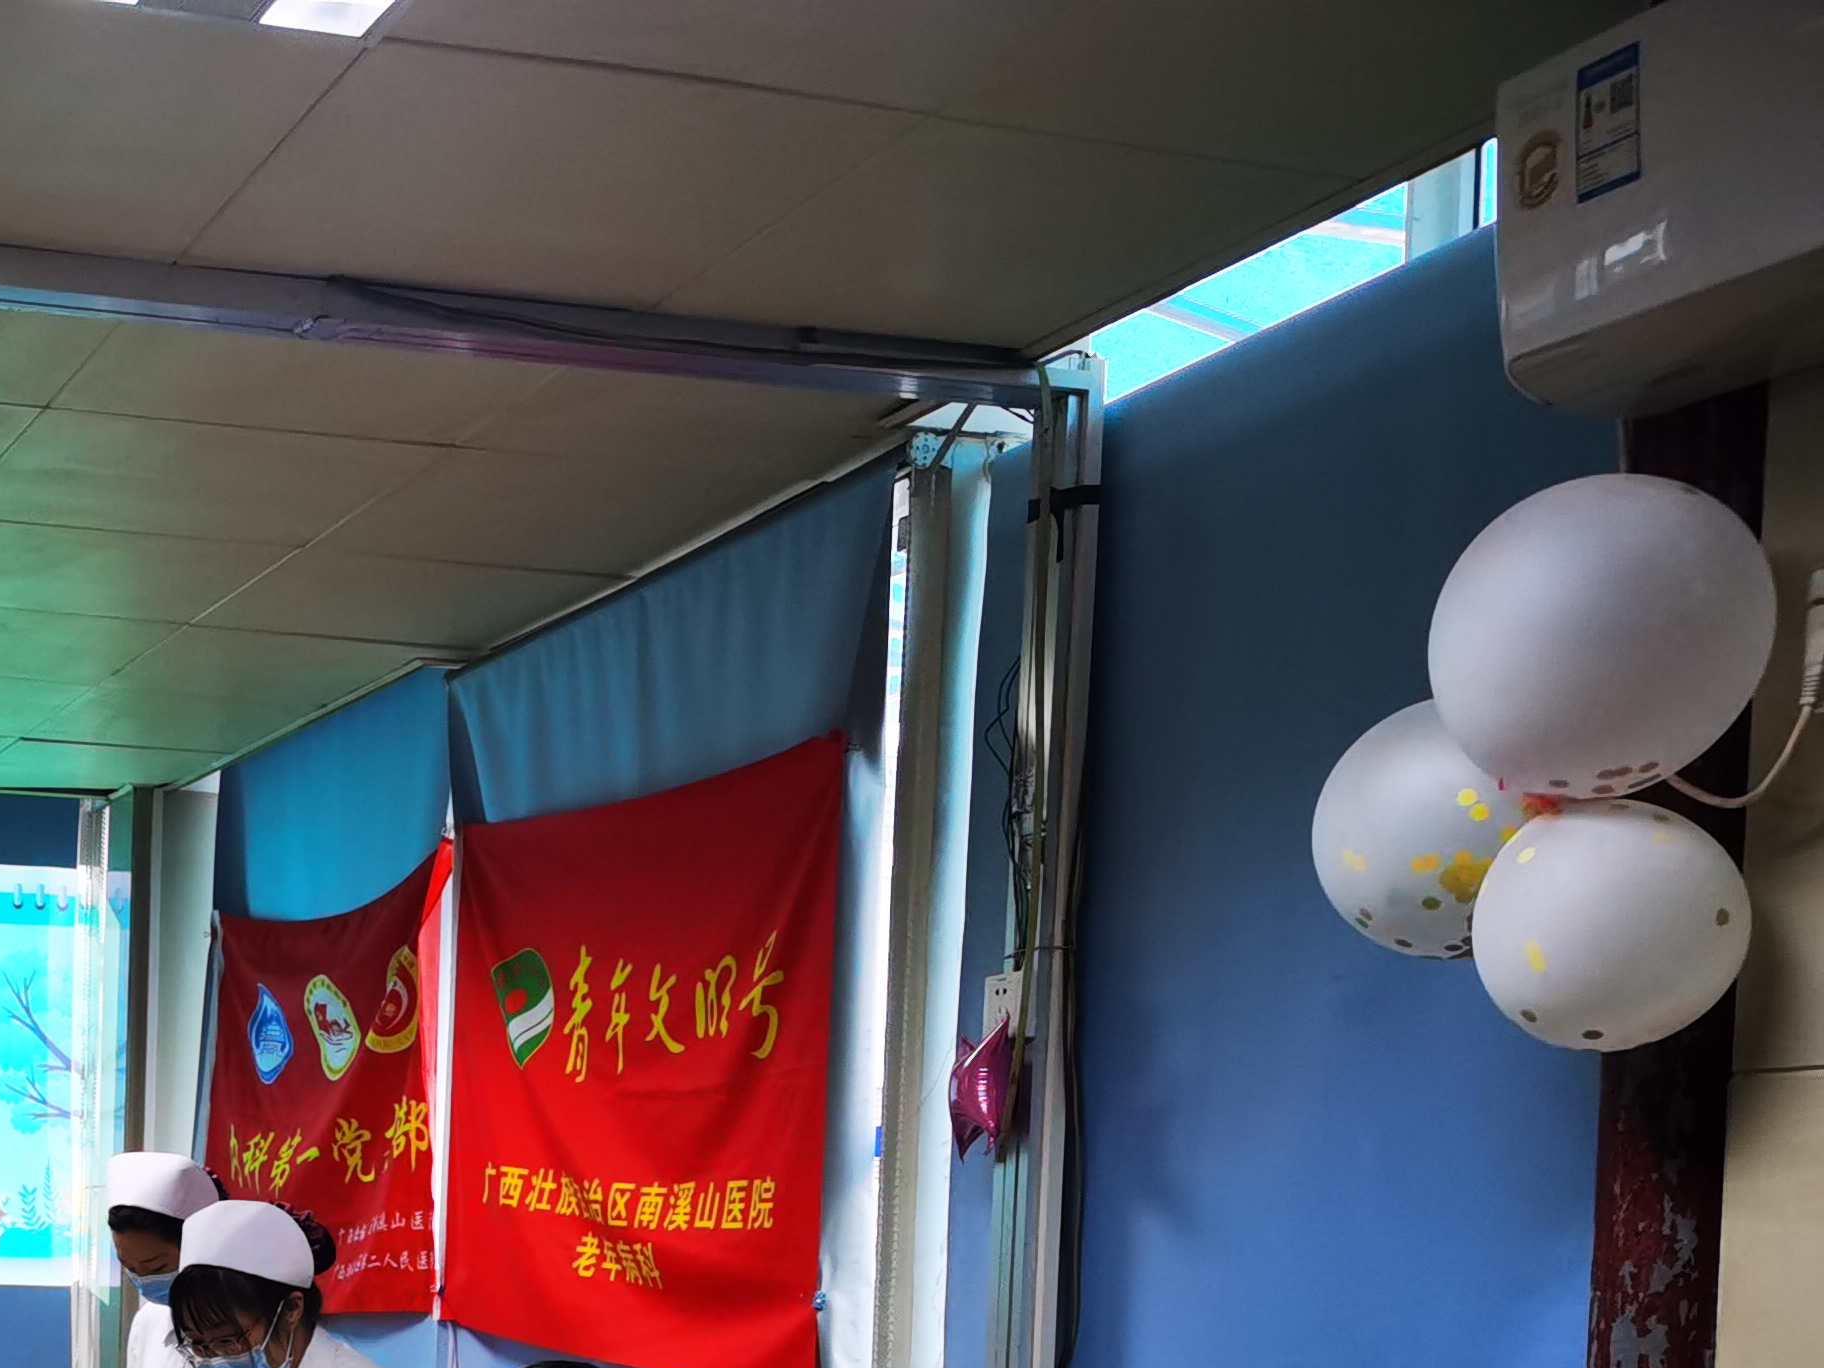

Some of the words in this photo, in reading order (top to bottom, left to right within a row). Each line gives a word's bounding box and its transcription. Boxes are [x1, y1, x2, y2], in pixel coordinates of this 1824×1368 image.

[562, 929, 785, 1083] 青年文明号
[229, 1095, 430, 1200] 内科第一党部
[482, 1161, 776, 1231] 广西壮族治区南溪山医院
[572, 1231, 664, 1290] 老年病科
